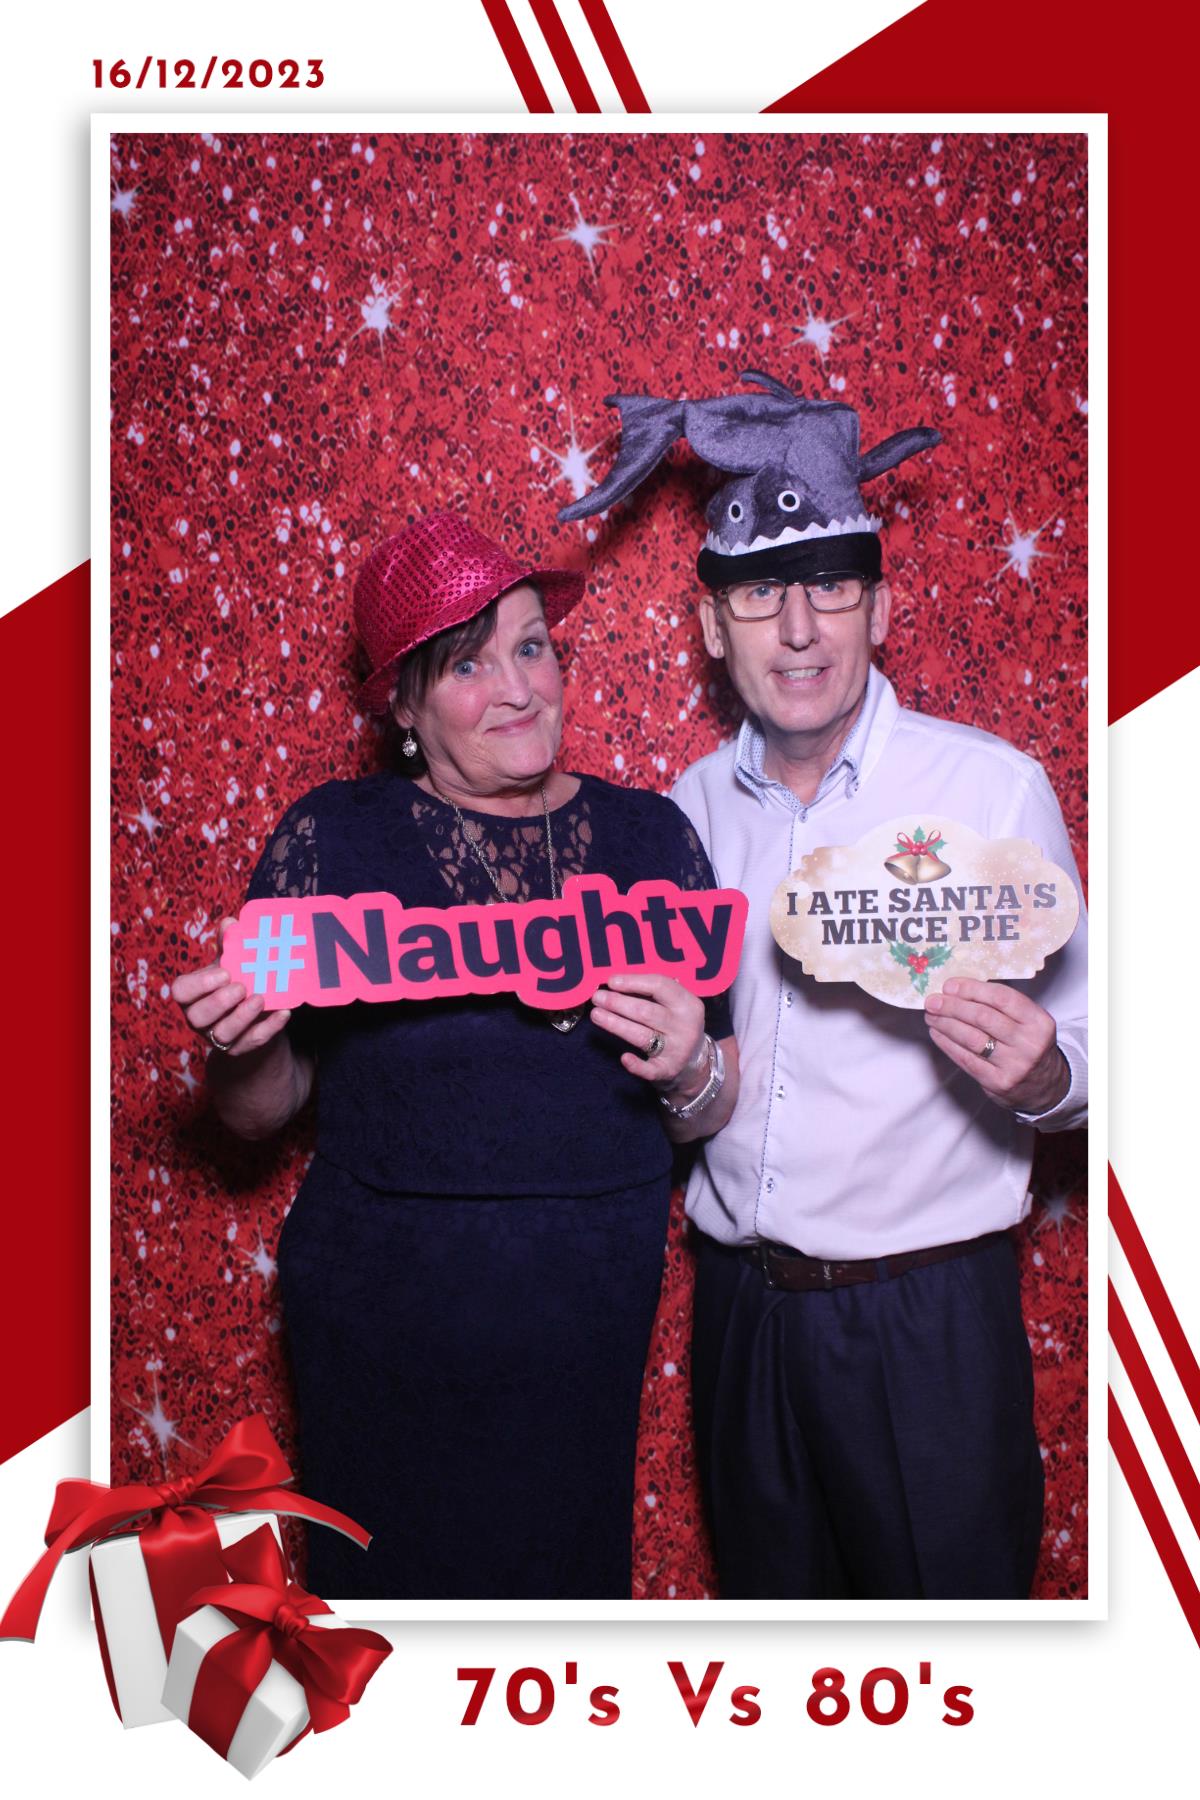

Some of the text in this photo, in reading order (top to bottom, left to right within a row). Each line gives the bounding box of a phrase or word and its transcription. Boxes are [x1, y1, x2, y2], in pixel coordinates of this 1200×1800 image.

[786, 883, 1057, 915] I ATE SANTA'S
[241, 890, 732, 994] #Naughty
[821, 914, 1020, 945] MINCE PIE
